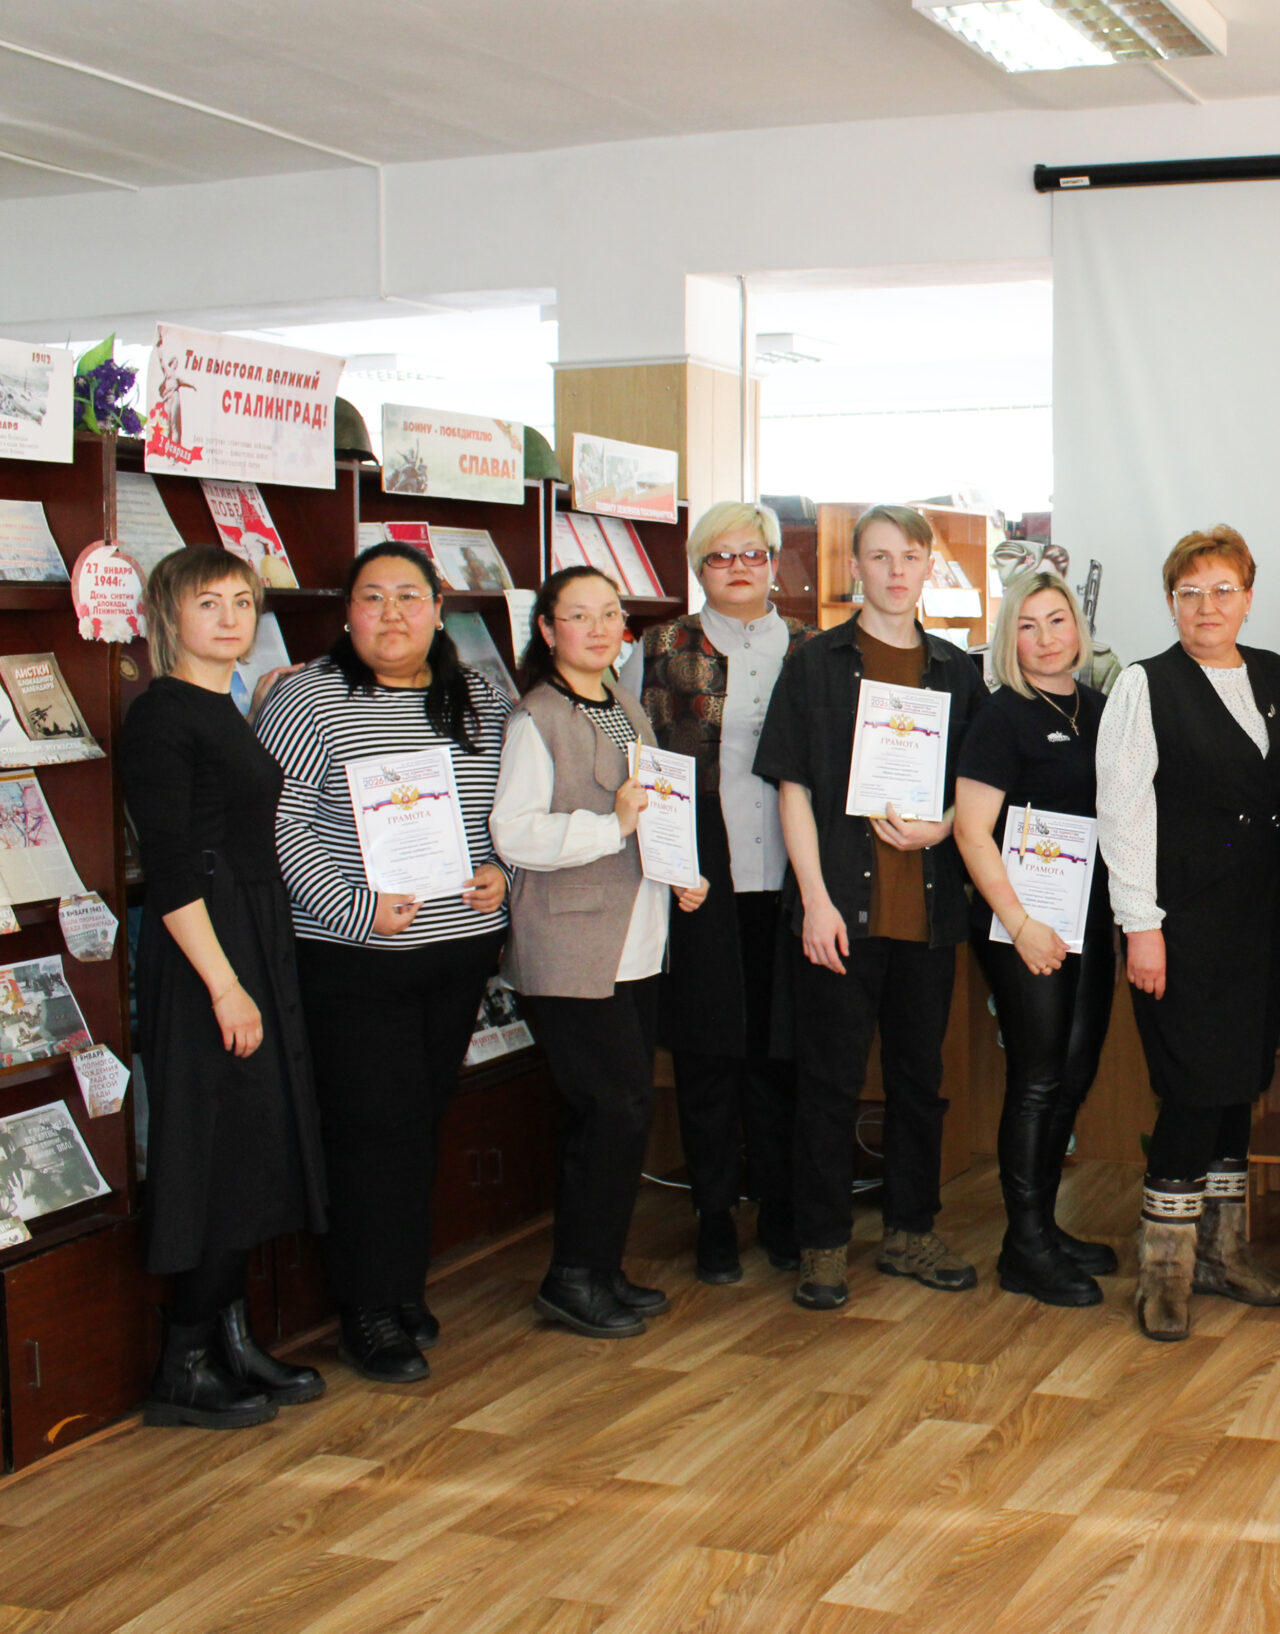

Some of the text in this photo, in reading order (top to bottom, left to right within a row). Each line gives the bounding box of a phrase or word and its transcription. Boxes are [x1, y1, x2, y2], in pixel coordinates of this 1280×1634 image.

[184, 349, 202, 371] Ты
[222, 390, 328, 430] СТАЛИНГРАД!
[0, 420, 18, 431] АРЯ
[439, 426, 492, 442] ПОБЕДИТЕЛЮ
[459, 454, 516, 479] СЛАВА!
[86, 563, 98, 574] 27
[387, 810, 432, 825] ГРАМОТА
[1025, 863, 1065, 876] ГРАМОТА
